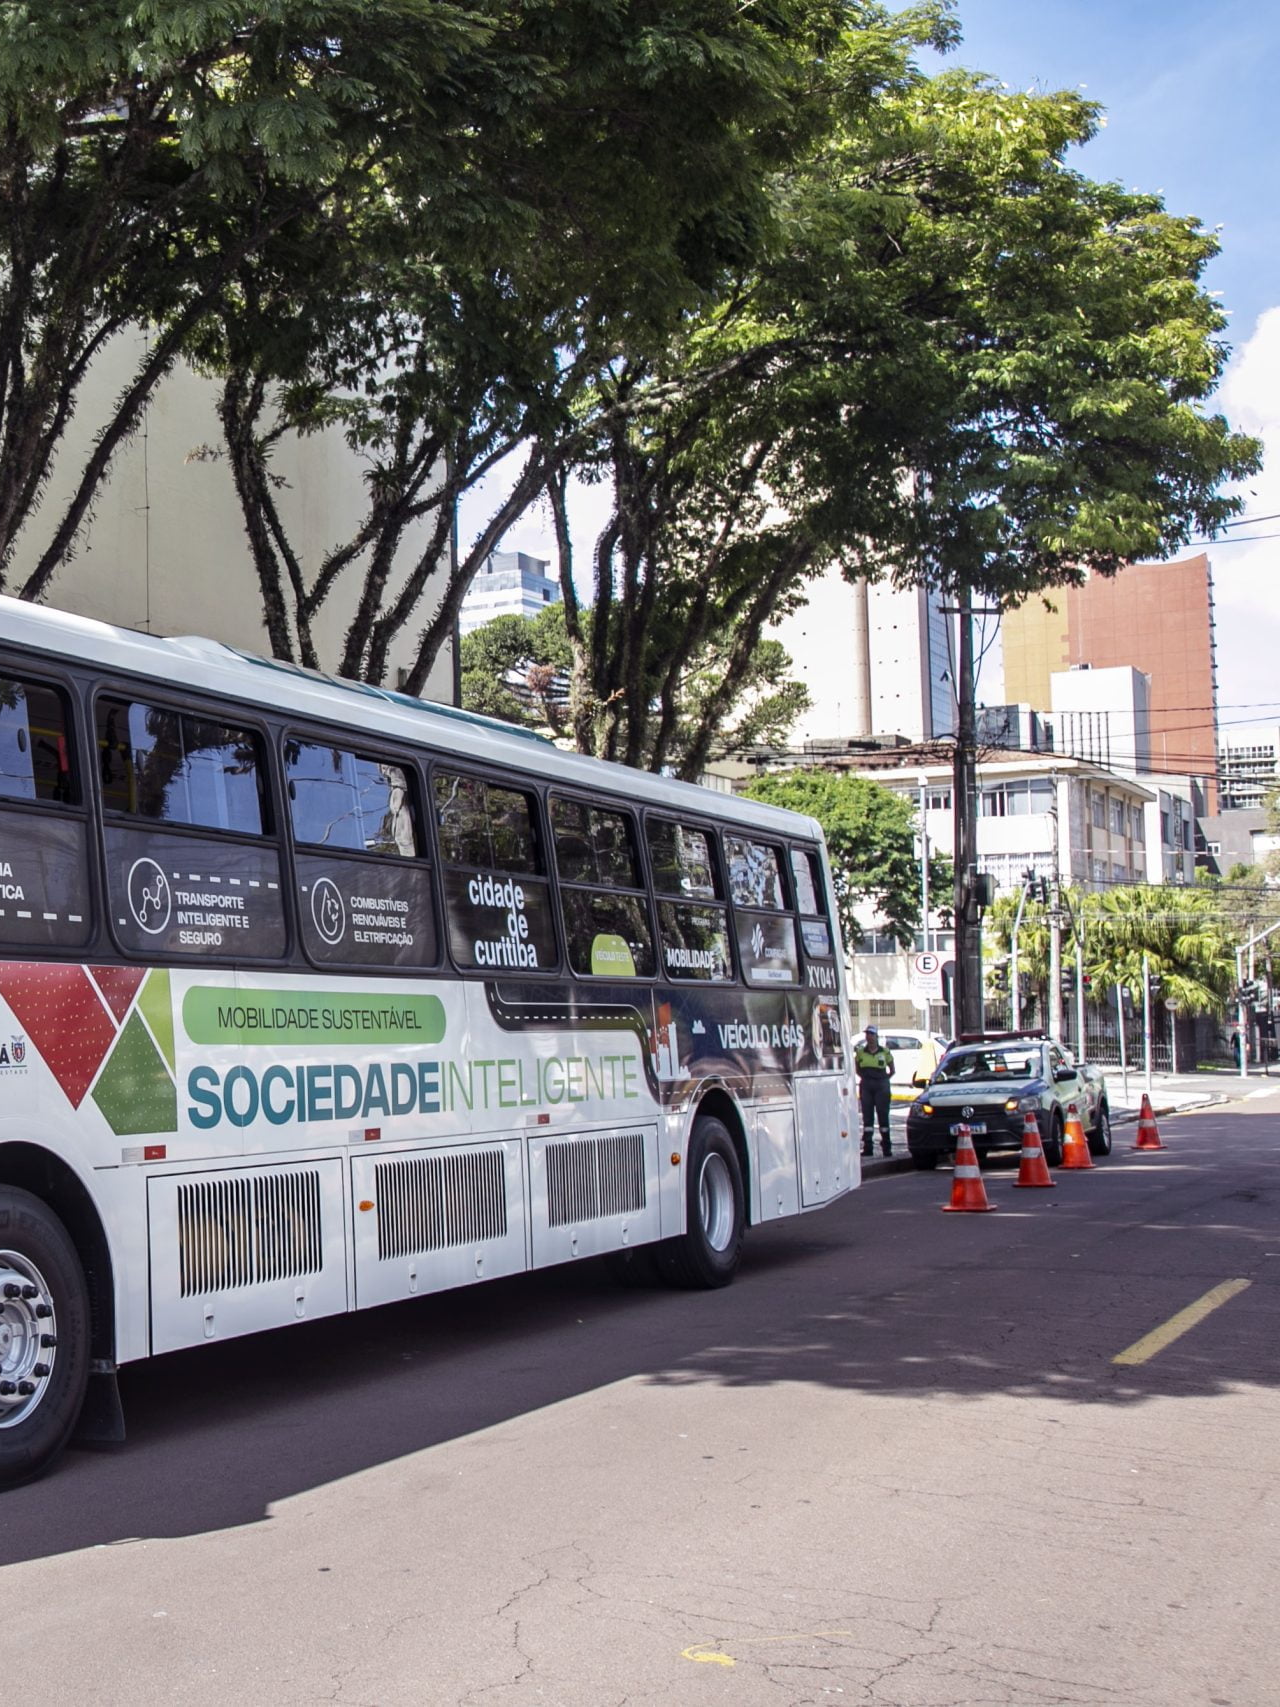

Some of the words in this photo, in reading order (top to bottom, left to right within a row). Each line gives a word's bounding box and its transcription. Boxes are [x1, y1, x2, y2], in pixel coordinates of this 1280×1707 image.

[175, 891, 244, 910] TRANSPORTE
[468, 874, 525, 909] cidade
[350, 896, 409, 912] COMBUSTÍVEIS
[177, 911, 242, 928] INTELIGENTE
[242, 915, 249, 928] E
[352, 912, 400, 928] RENOVÁVEIS
[400, 917, 407, 928] E
[507, 906, 528, 938] de
[179, 930, 222, 946] SEGURO
[354, 929, 413, 947] ELETRIFICAÇÃO
[474, 936, 538, 967] curitiba
[667, 948, 715, 968] MOBILIDADE
[923, 957, 931, 969] E
[807, 965, 837, 989] XY041
[218, 1006, 319, 1029] MOBILIDADE
[322, 1006, 422, 1030] SUSTENTÁVEL
[717, 1018, 770, 1049] VEÍCULO
[772, 1024, 781, 1048] A
[781, 1019, 805, 1049] GÁS
